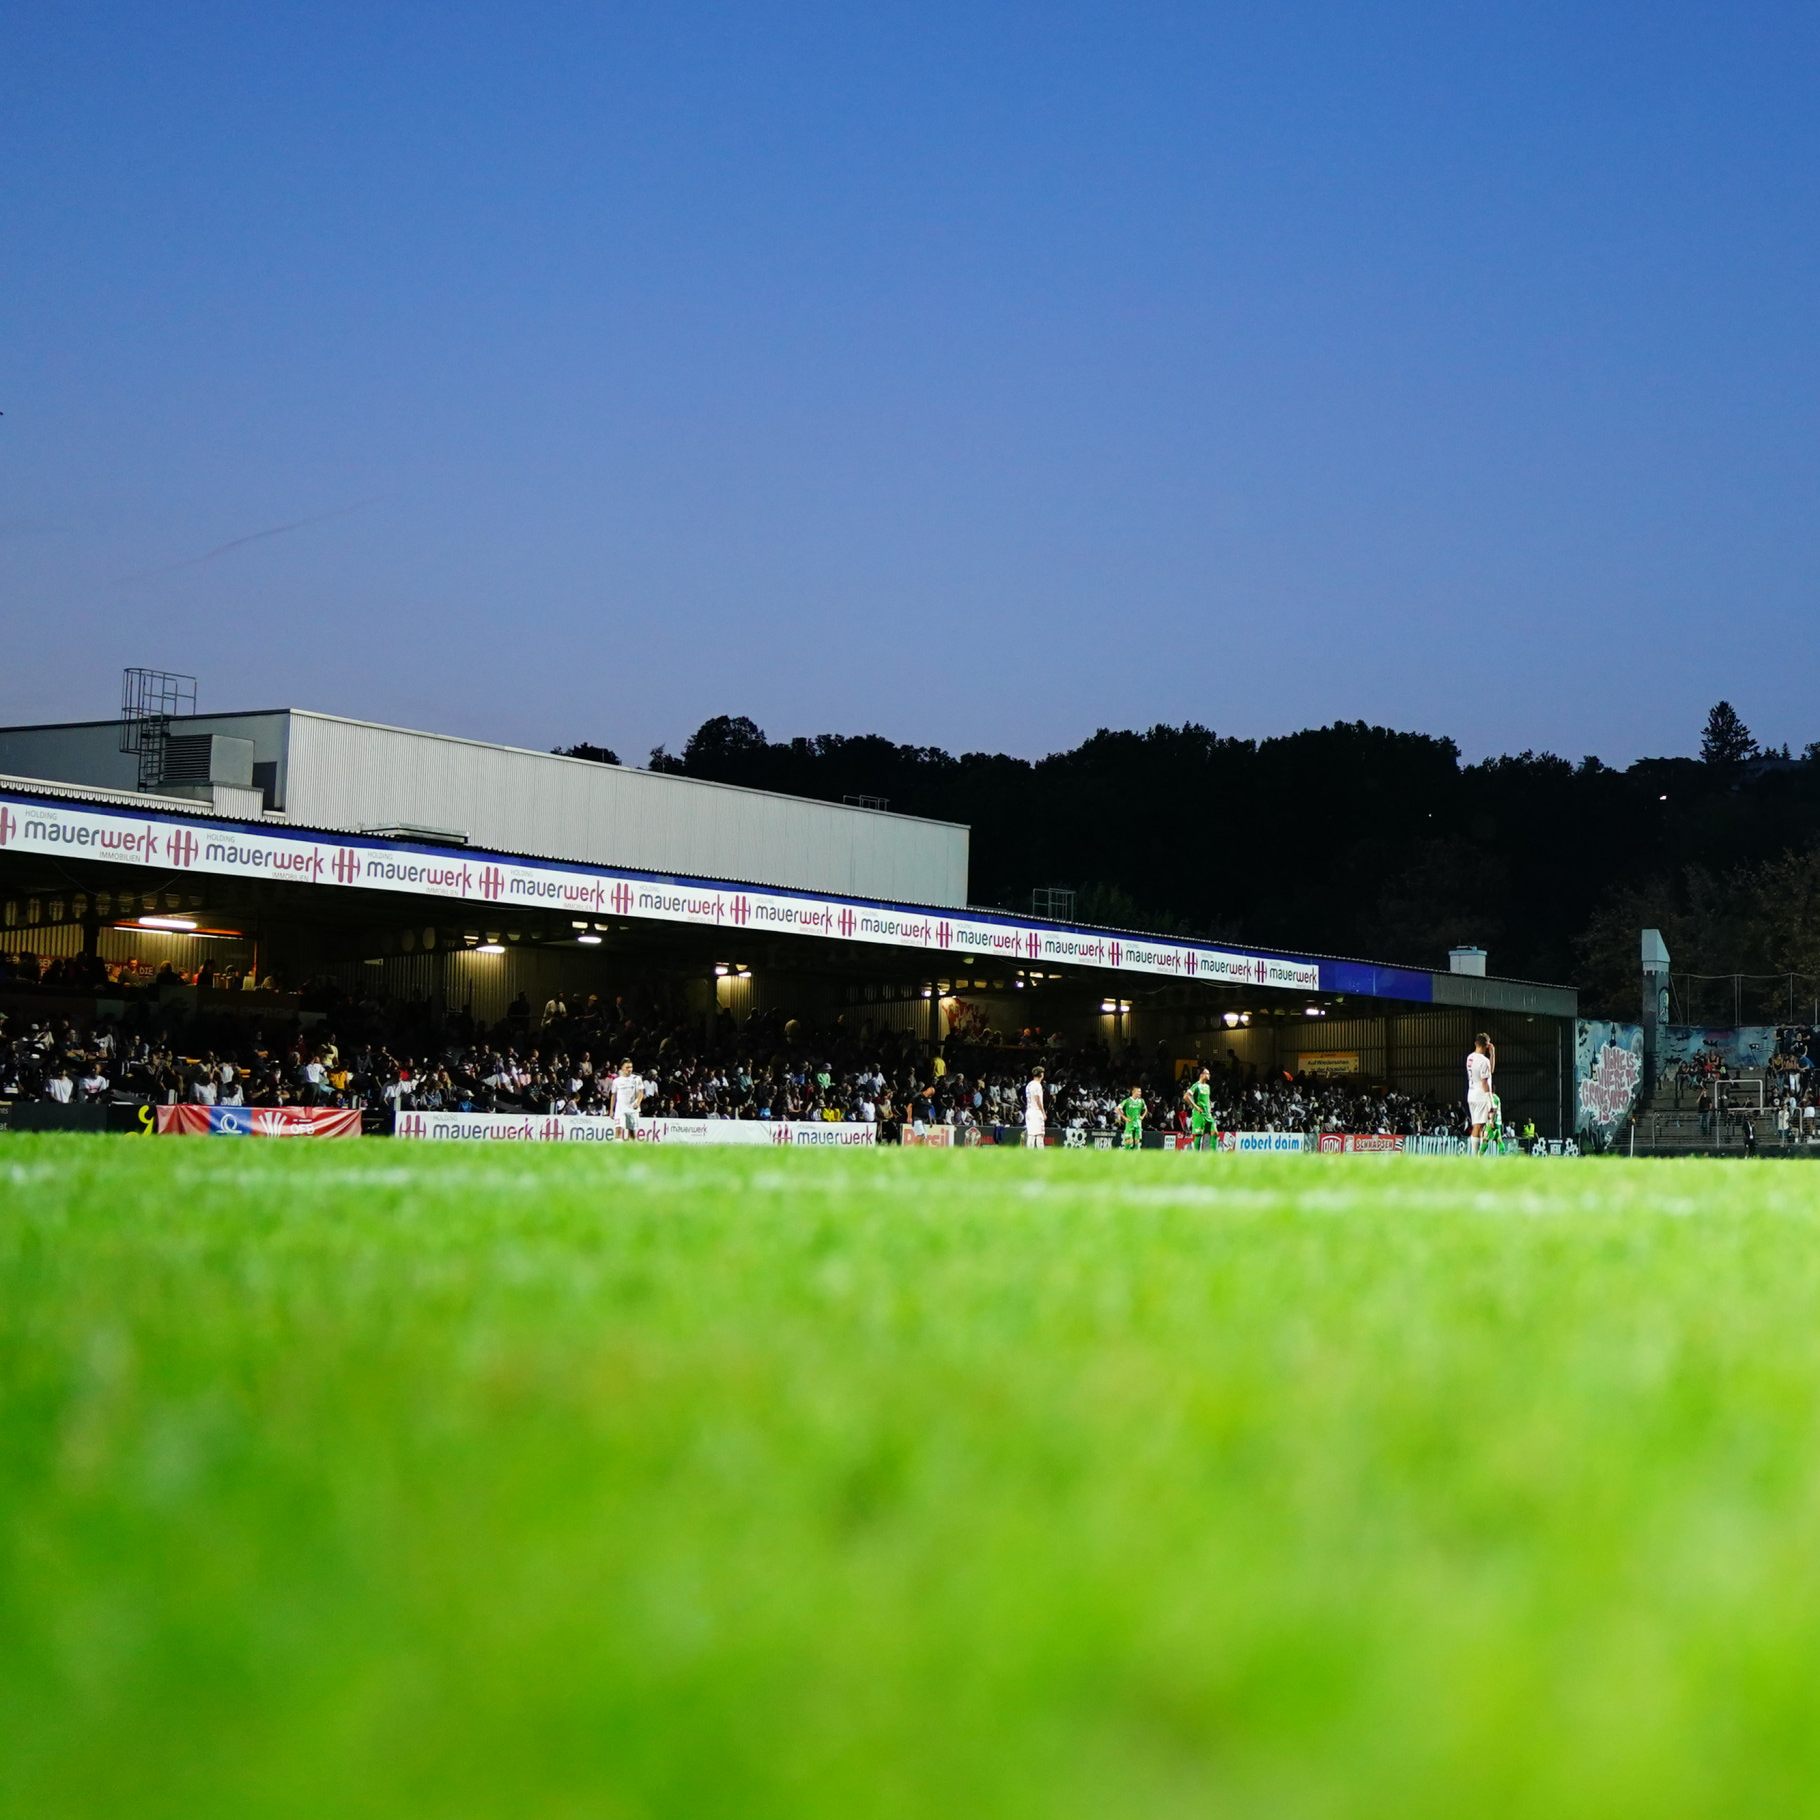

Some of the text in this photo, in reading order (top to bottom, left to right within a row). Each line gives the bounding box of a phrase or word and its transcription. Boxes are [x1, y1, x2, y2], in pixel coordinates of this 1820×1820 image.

[25, 809, 57, 821] HOLDING
[24, 820, 158, 863] mauerwerk
[207, 833, 236, 844] HOLDING
[100, 851, 140, 863] IMMOBILIEN
[206, 843, 324, 883] mauerwerk
[367, 861, 472, 897] mauerwerk
[510, 878, 605, 912] mauerwerk
[639, 893, 725, 925] mauerwerk
[755, 905, 833, 935] mauerwerk
[861, 918, 931, 946] mauerwerk
[956, 929, 1022, 957] mauerwerk
[1045, 938, 1105, 964] mauerwerk
[1126, 949, 1181, 974] mauerwerk
[1200, 959, 1252, 983] mauerwerk
[1269, 967, 1317, 991] mauerwerk
[433, 1118, 534, 1140] mauerwerk
[670, 1123, 708, 1137] mauerwerk
[797, 1123, 873, 1146] mauerwerk
[1240, 1135, 1299, 1150] robert daim
